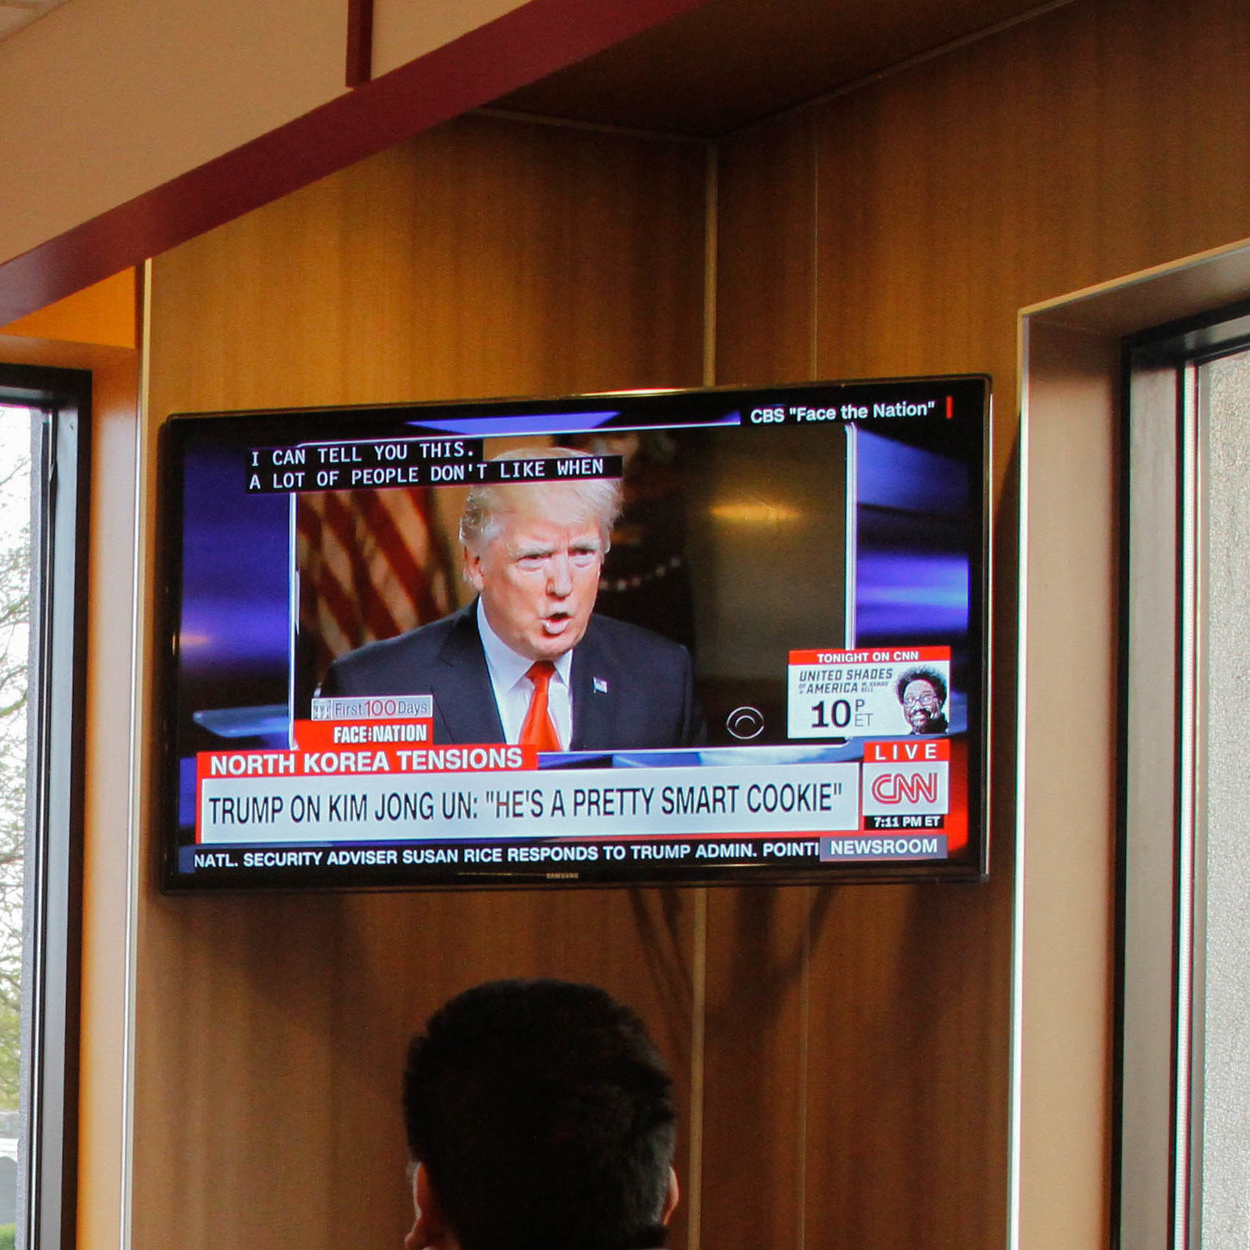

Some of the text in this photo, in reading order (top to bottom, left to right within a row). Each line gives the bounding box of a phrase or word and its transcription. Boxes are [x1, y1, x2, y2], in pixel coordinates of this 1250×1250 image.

[751, 401, 935, 423] CBS "Face the Nation"
[251, 442, 474, 467] I CAN TELL YOU THIS.
[250, 459, 604, 490] A LOT OF PEOPLE DON'T LIKE WHEN
[817, 651, 919, 663] TONIGHT ON CNN
[799, 668, 893, 682] UNITED SHADES
[806, 682, 858, 694] AMERICA
[335, 700, 428, 716] First 100 Days
[811, 699, 866, 728] 10 P
[854, 713, 874, 727] ET
[875, 744, 937, 760] LIVE
[210, 749, 523, 776] NORTH KOREA TENSIONS
[871, 773, 938, 804] CNN
[209, 783, 842, 824] TRUMP ON KIM JONG UN: "HE'S A PRETTY SMART COOKIE"
[874, 816, 940, 828] 7:11 PM ET
[194, 853, 239, 868] NATL.
[243, 852, 322, 867] SECURITY
[326, 850, 398, 865] ADVISER
[402, 849, 458, 864] SUSAN
[464, 848, 501, 863] RICE
[507, 846, 598, 862] RESPONDS
[603, 846, 625, 860] TO
[630, 844, 690, 860] TRUMP
[695, 842, 757, 858] ADMIN.
[831, 839, 938, 855] NEWSROOM
